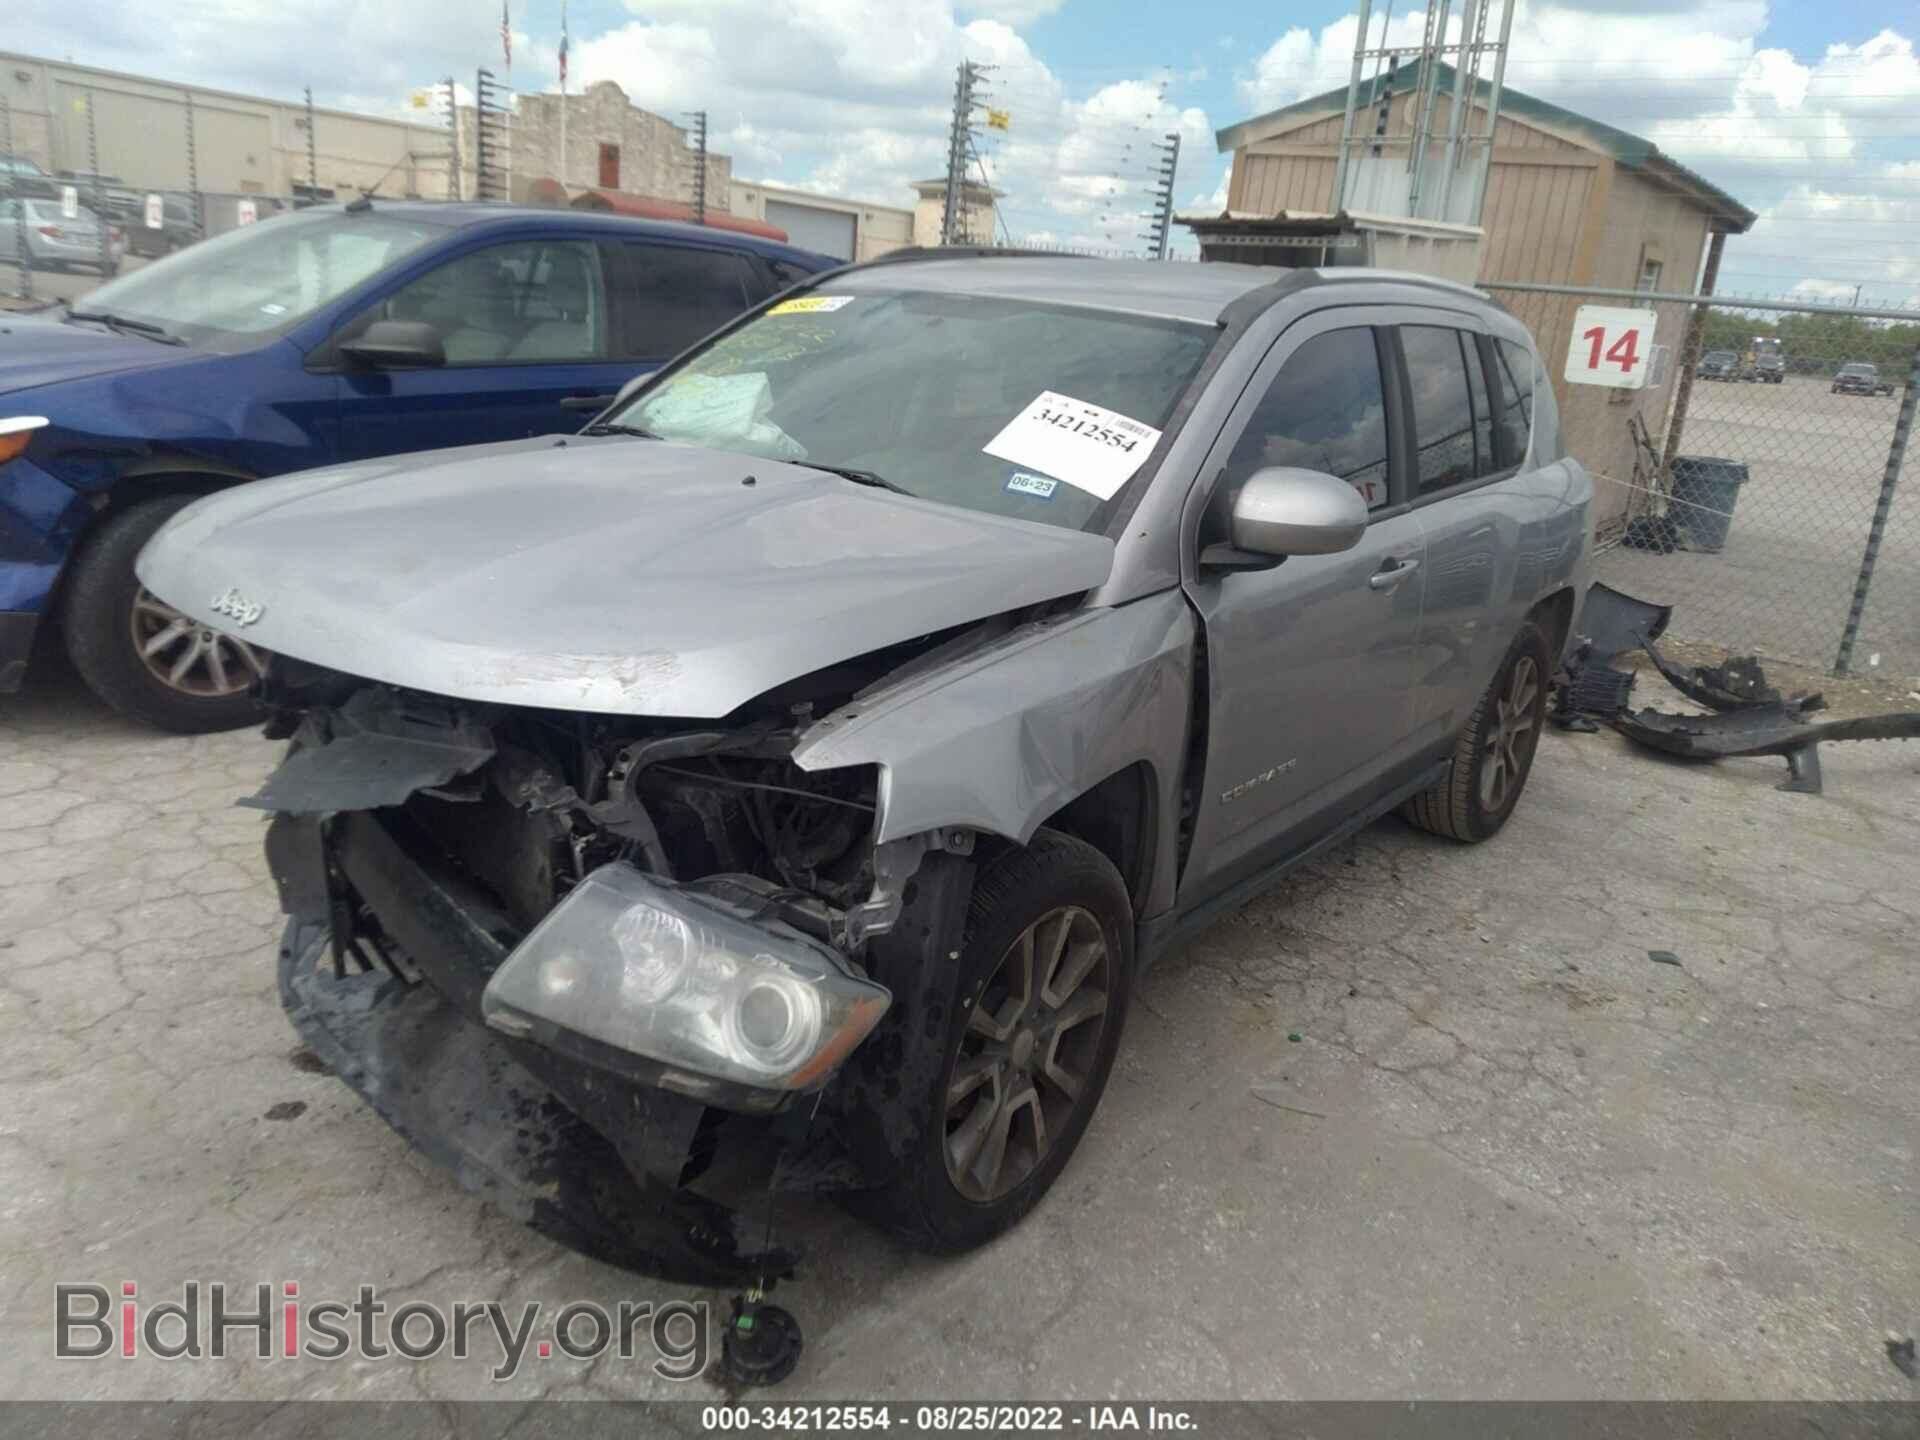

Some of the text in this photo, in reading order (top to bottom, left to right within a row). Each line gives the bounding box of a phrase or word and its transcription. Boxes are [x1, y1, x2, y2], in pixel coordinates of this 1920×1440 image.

[1584, 327, 1640, 372] 14
[1033, 408, 1138, 453] 34212554
[209, 588, 265, 629] Jeep
